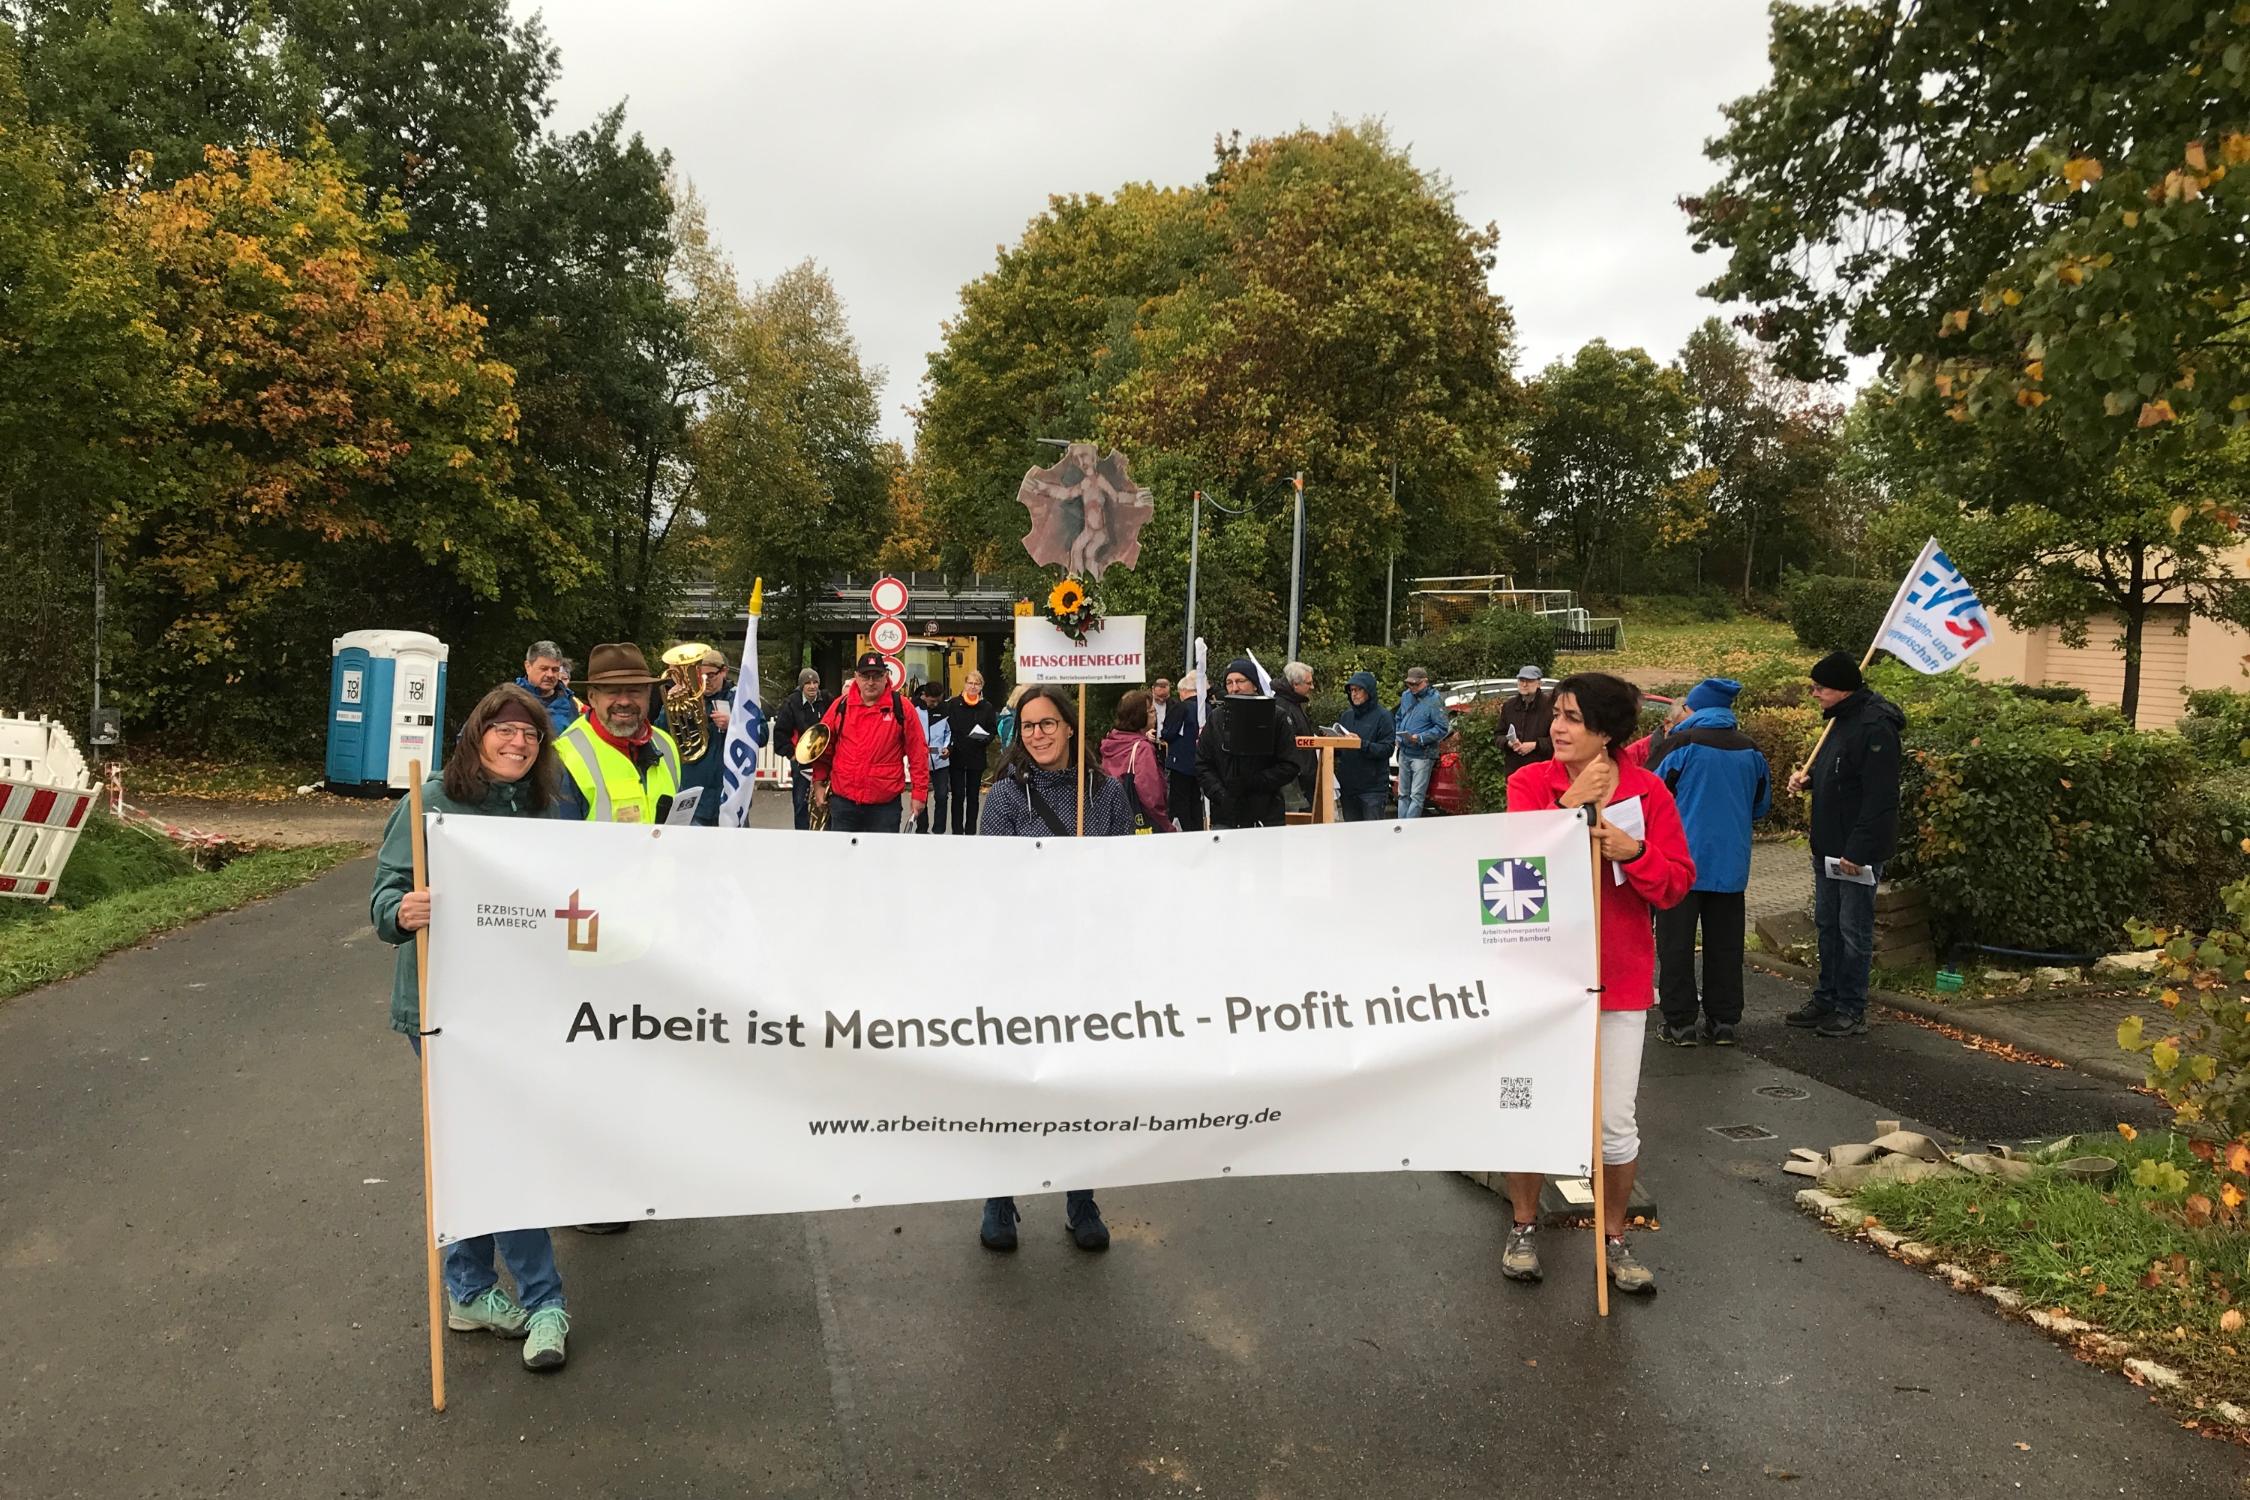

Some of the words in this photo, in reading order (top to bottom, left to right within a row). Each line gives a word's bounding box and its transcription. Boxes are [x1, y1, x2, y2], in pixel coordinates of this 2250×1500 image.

[1932, 638, 1957, 662] und
[1020, 653, 1142, 667] MENSCHENRECHT
[477, 904, 547, 918] ERZBISTUM
[477, 917, 537, 929] BAMBERG
[1482, 926, 1550, 935] Arbeitnehmerpastoral
[1519, 935, 1551, 943] Bamberg
[566, 1002, 730, 1043] Arbeit
[748, 1010, 806, 1047] ist
[825, 1000, 1185, 1049] Menschenrecht
[1196, 1016, 1212, 1025] -
[1225, 991, 1353, 1034] Profit
[1365, 980, 1490, 1025] nicht!
[809, 1107, 1282, 1137] www.arbeitnehmerpastoral-bamberg.de
